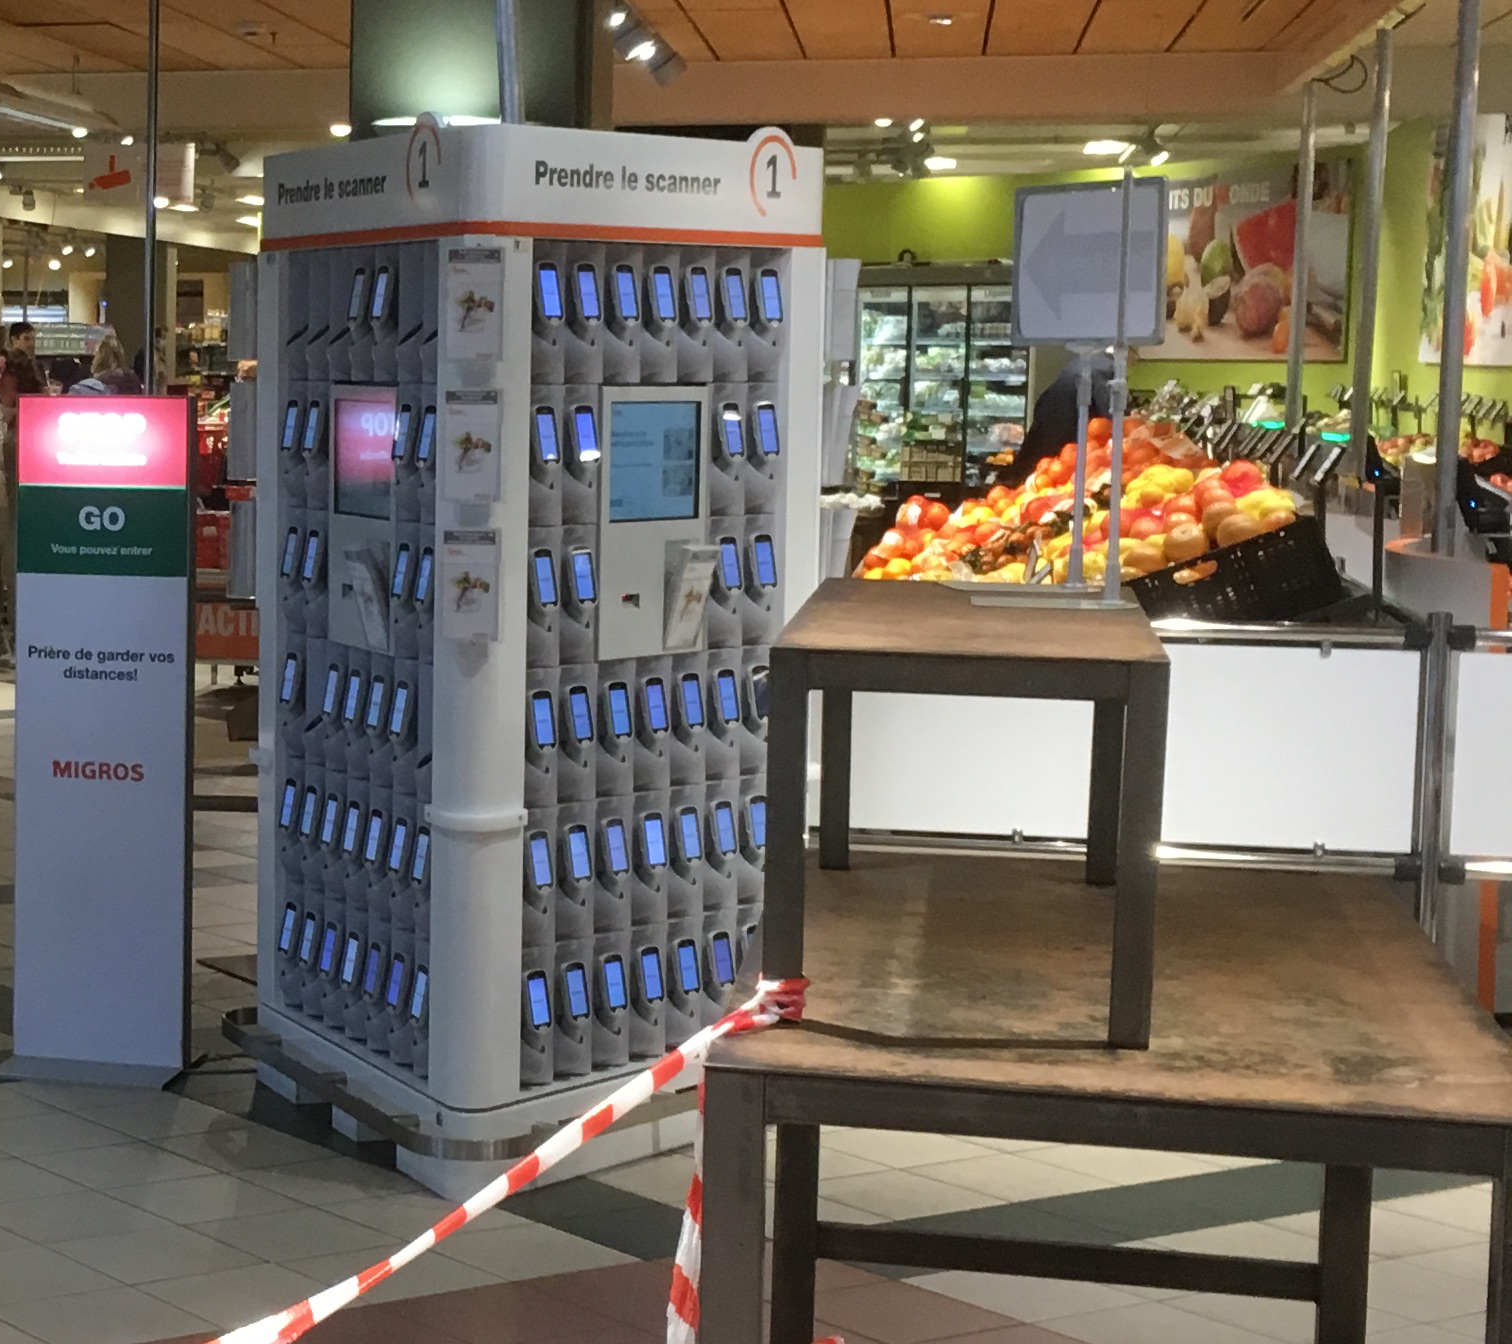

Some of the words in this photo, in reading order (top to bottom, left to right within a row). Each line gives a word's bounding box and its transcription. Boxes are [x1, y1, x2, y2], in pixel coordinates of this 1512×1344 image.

[418, 141, 430, 188] 1
[765, 154, 782, 199] 1
[278, 180, 320, 205] Prendre
[324, 177, 334, 200] le
[338, 175, 387, 199] scanner
[535, 159, 614, 190] Prendre
[621, 165, 638, 191] le
[645, 171, 721, 196] scanner
[1169, 187, 1190, 210] ITS
[1193, 185, 1214, 207] DU
[78, 506, 126, 531] GO
[51, 544, 77, 554] Vous
[80, 546, 117, 556] pouvez
[121, 545, 153, 555] entrer
[196, 603, 260, 637] ACTI
[28, 645, 71, 660] Prière
[75, 648, 93, 661] de
[97, 649, 145, 664] garder
[149, 652, 175, 664] vos
[63, 666, 138, 681] distances!
[52, 759, 145, 782] MIGROS
